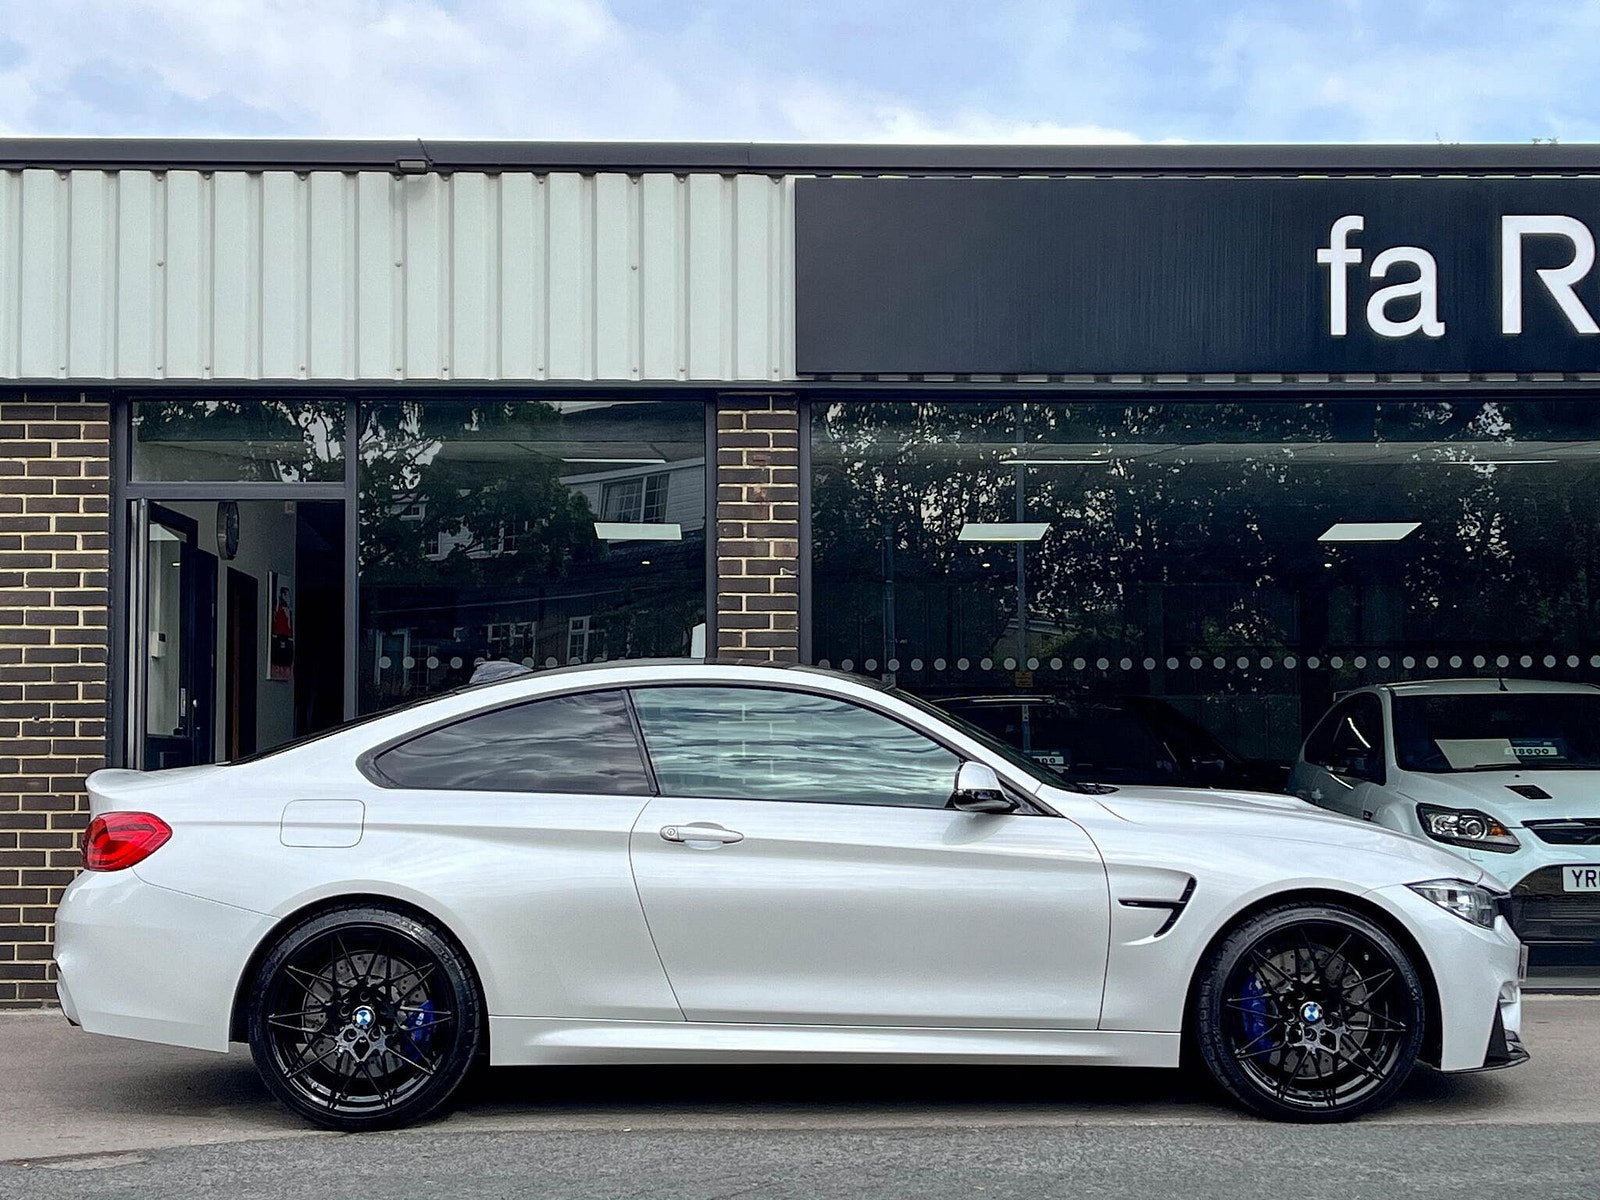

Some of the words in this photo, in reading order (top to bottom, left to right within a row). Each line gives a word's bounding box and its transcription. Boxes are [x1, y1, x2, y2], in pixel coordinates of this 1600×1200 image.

[1316, 214, 1446, 338] fa
[1501, 214, 1600, 335] R
[1571, 869, 1600, 888] YR
